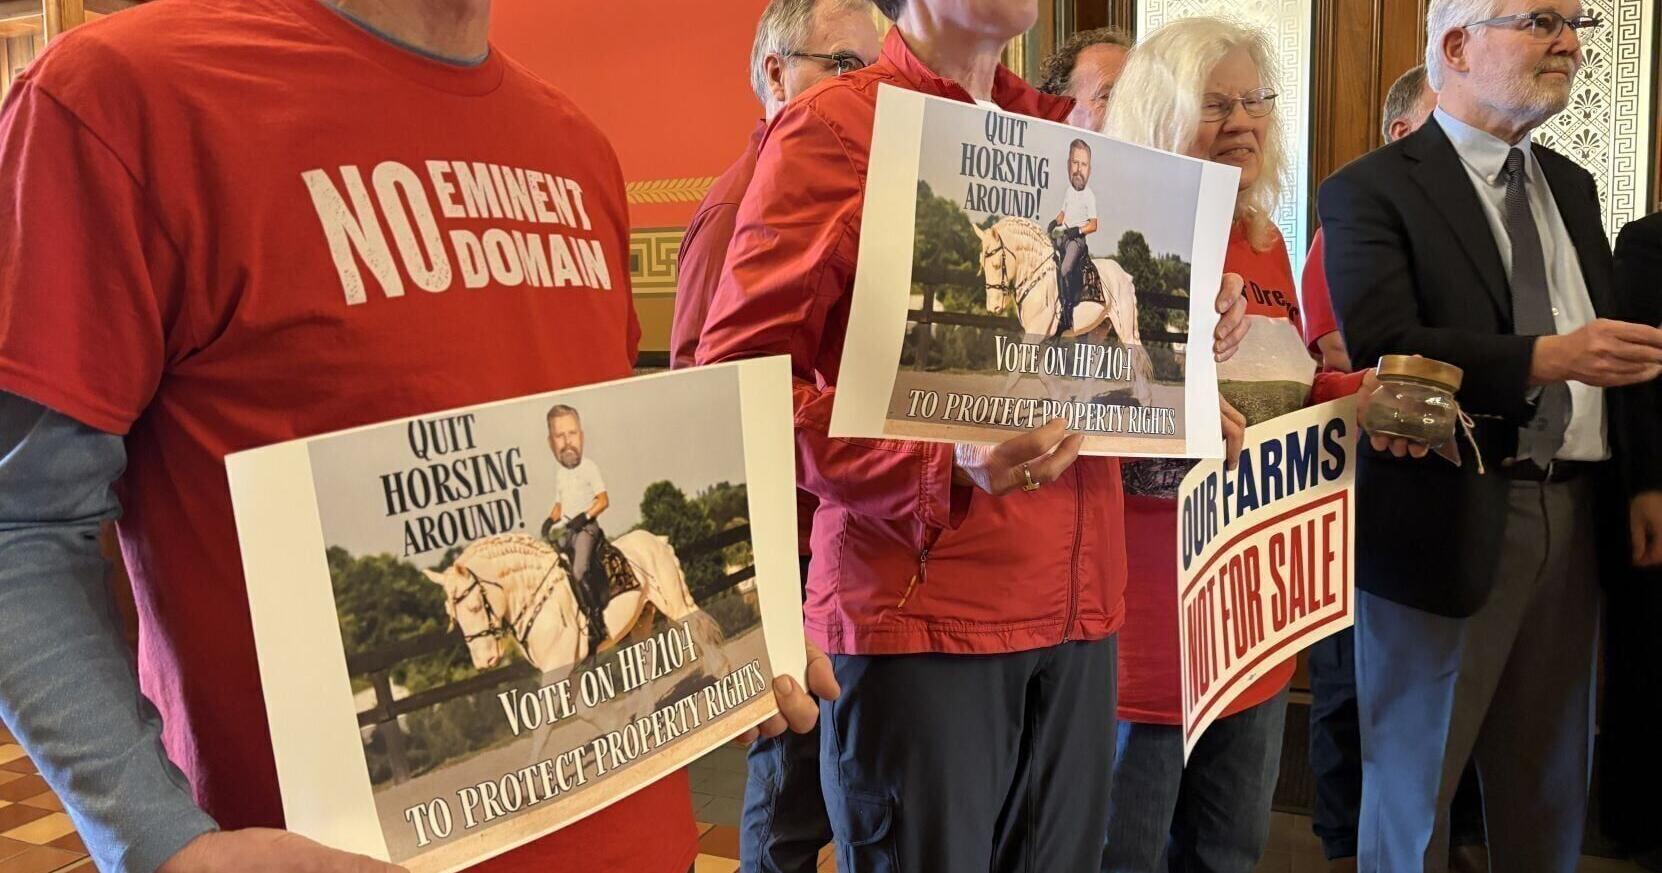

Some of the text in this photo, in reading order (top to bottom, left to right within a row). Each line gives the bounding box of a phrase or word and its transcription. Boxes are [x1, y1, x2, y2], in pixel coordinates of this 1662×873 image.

[985, 111, 1028, 149] QUIT
[425, 160, 591, 230] EMINENT
[960, 143, 1049, 189] HORSING
[301, 161, 452, 305] NO
[963, 182, 1042, 220] AROUND!
[450, 228, 612, 290] DOMAIN
[1044, 346, 1067, 376] ON
[1072, 343, 1133, 381] HF2104
[408, 413, 477, 462] QUIT
[907, 389, 1176, 435] TO PROTECT PROPERTY RIGHTS
[379, 447, 528, 517] HORSING
[1182, 417, 1347, 571] OUR FARMS
[403, 488, 526, 557] AROUND!
[1187, 511, 1336, 714] NOT FOR SALE
[580, 662, 616, 709] ON
[616, 621, 699, 695] HF2104
[405, 659, 767, 848] TO PROTECT PROPERTY RIGHTS
